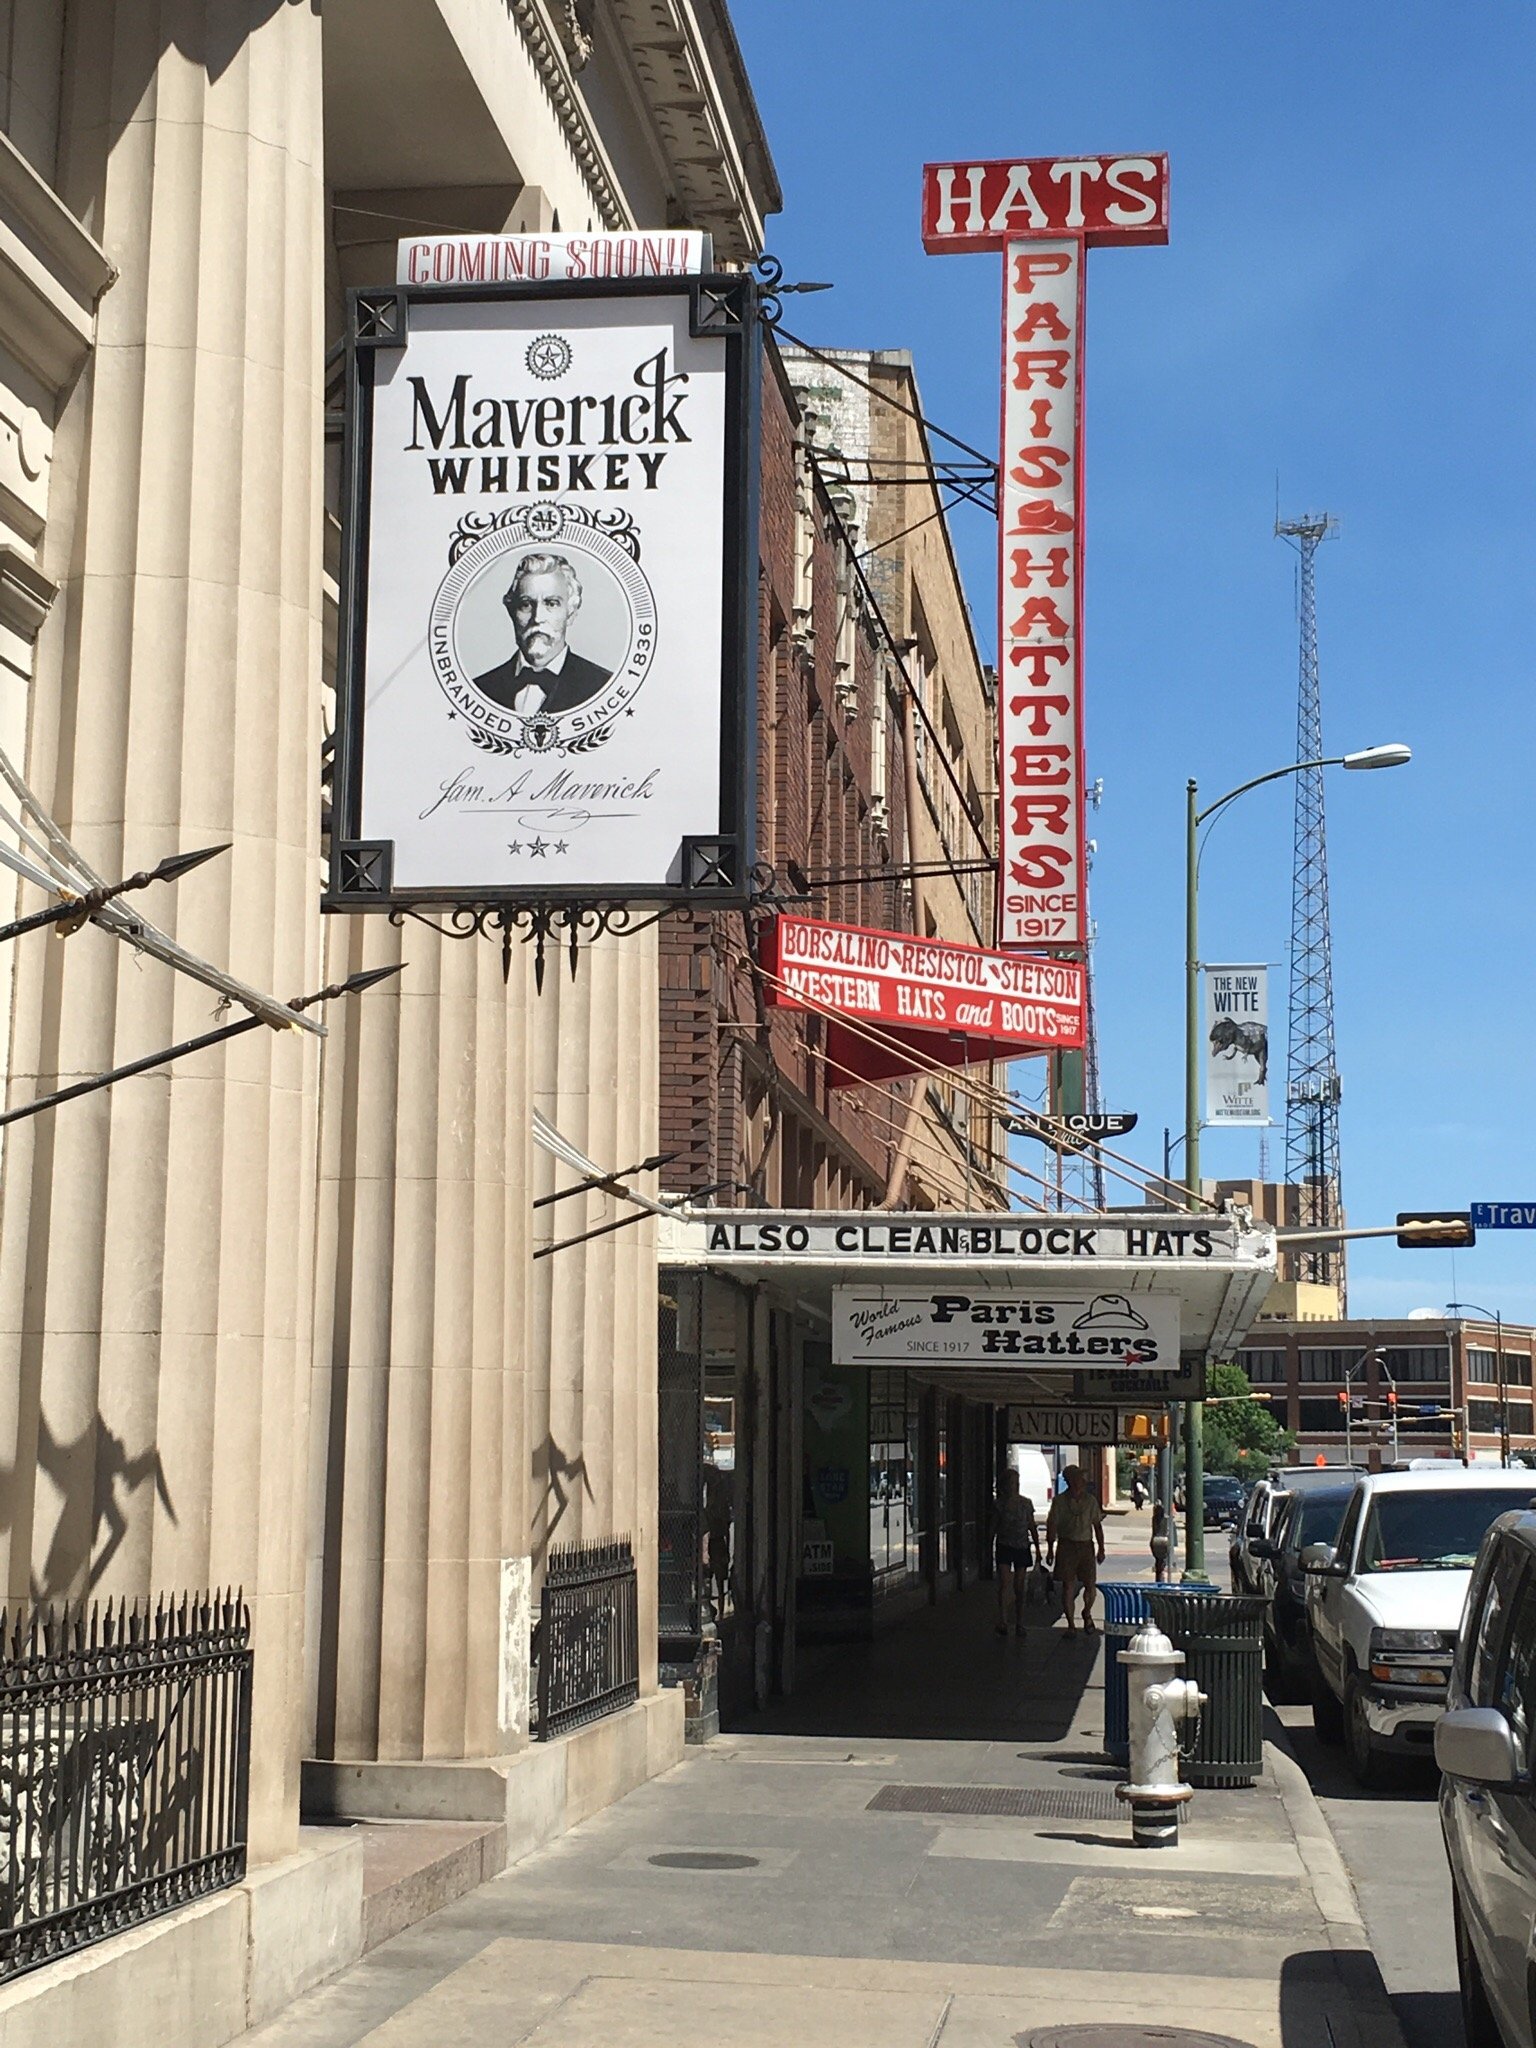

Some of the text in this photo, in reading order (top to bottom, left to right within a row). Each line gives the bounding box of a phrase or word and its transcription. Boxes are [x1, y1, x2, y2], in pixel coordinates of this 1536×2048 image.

[936, 158, 1158, 233] HATS
[408, 237, 690, 284] COMING SOON!!
[404, 346, 692, 451] Maverick
[427, 452, 668, 495] WHISKEY
[1008, 252, 1073, 889] PARIS HATTERS
[434, 623, 652, 733] UNBRANDED SINCE 1836
[529, 768, 661, 801] Maverick
[1007, 893, 1077, 914] SINCE
[1016, 919, 1067, 937] 1917
[784, 922, 1077, 1000] BORSALINO RESISTOL STETSON
[1213, 977, 1257, 991] THE NEW
[782, 966, 1058, 1037] WESTERN HATS and BOOTS
[1213, 991, 1259, 1013] WITTE
[1056, 1013, 1080, 1026] SINCE
[1060, 1025, 1077, 1035] 1917
[1477, 1204, 1484, 1216] E
[709, 1224, 810, 1251] ALSO
[1127, 1228, 1213, 1257] HATS
[849, 1299, 900, 1329] World
[930, 1296, 1056, 1324] Paris
[861, 1314, 922, 1347] Famous
[981, 1330, 1159, 1362] Hatters
[907, 1340, 970, 1353] SINCE 1917
[1011, 1411, 1111, 1439] ANTIQUES
[803, 1543, 832, 1560] ATM
